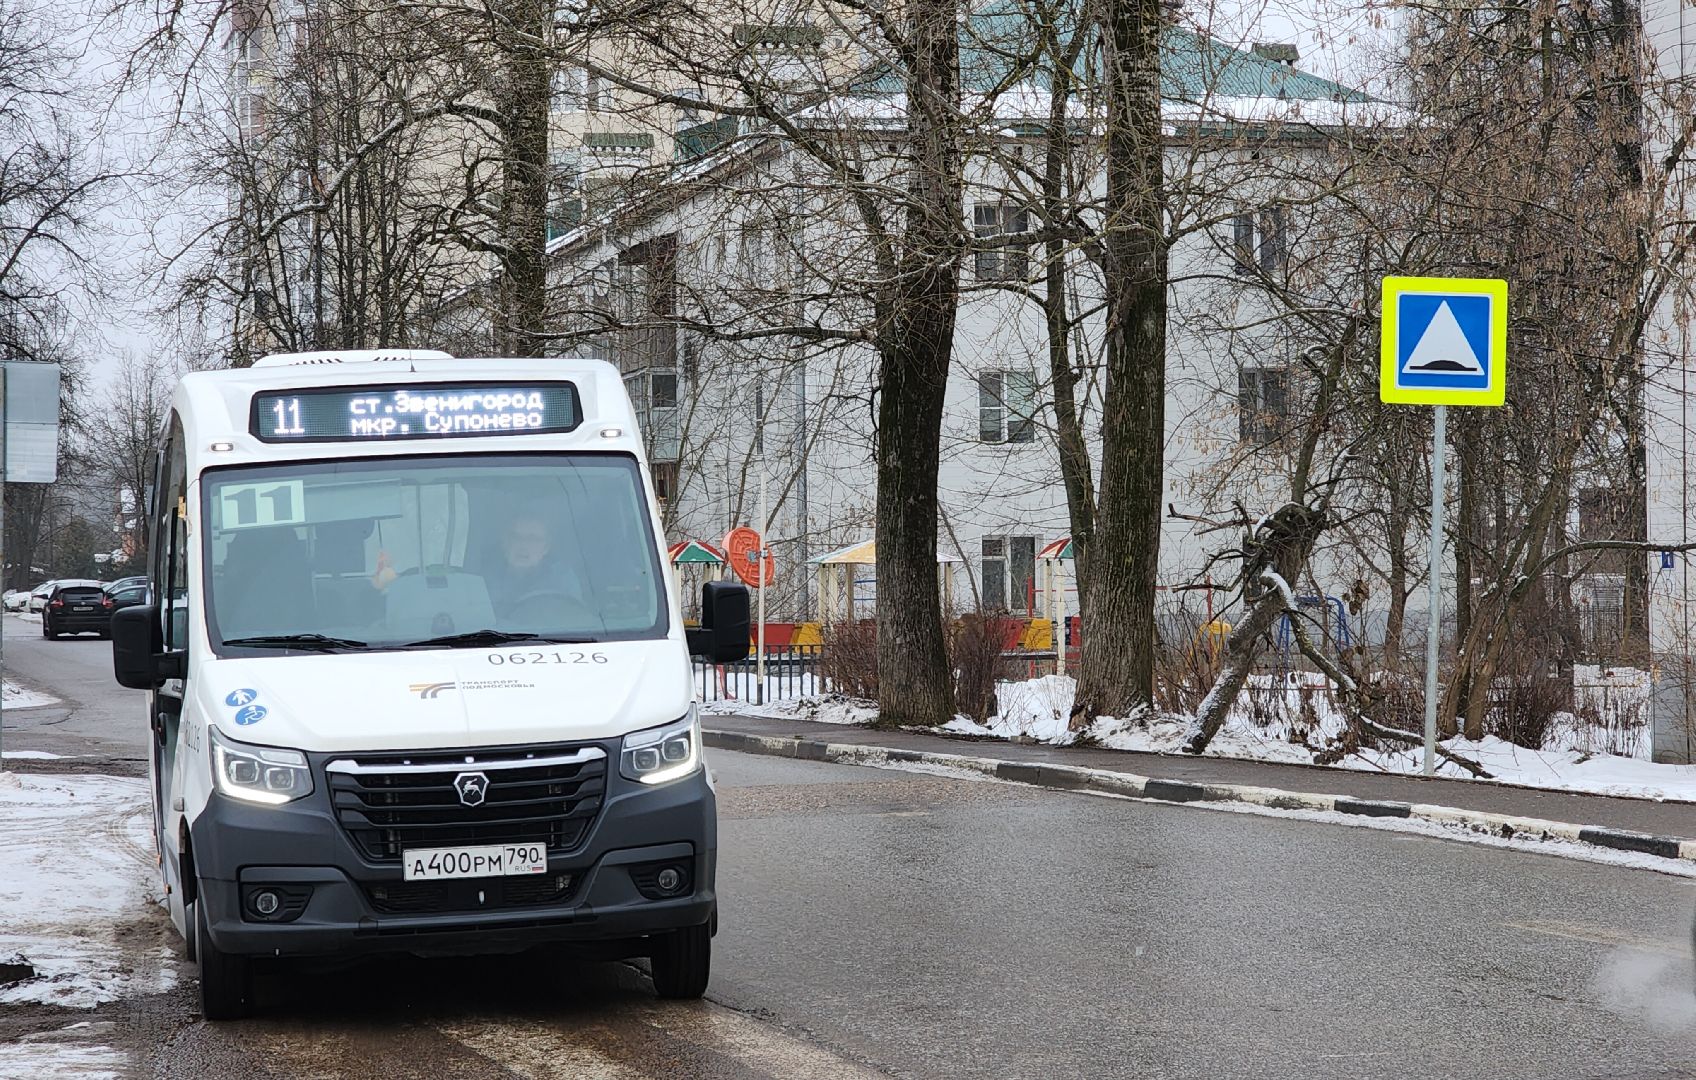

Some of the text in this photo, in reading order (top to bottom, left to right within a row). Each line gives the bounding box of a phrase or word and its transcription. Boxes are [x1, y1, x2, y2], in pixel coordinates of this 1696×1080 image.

[273, 398, 305, 434] 11
[351, 412, 543, 436] мкр. Супонево
[224, 485, 293, 525] 11
[487, 651, 609, 666] 062126
[413, 847, 539, 876] А400РМ 790
